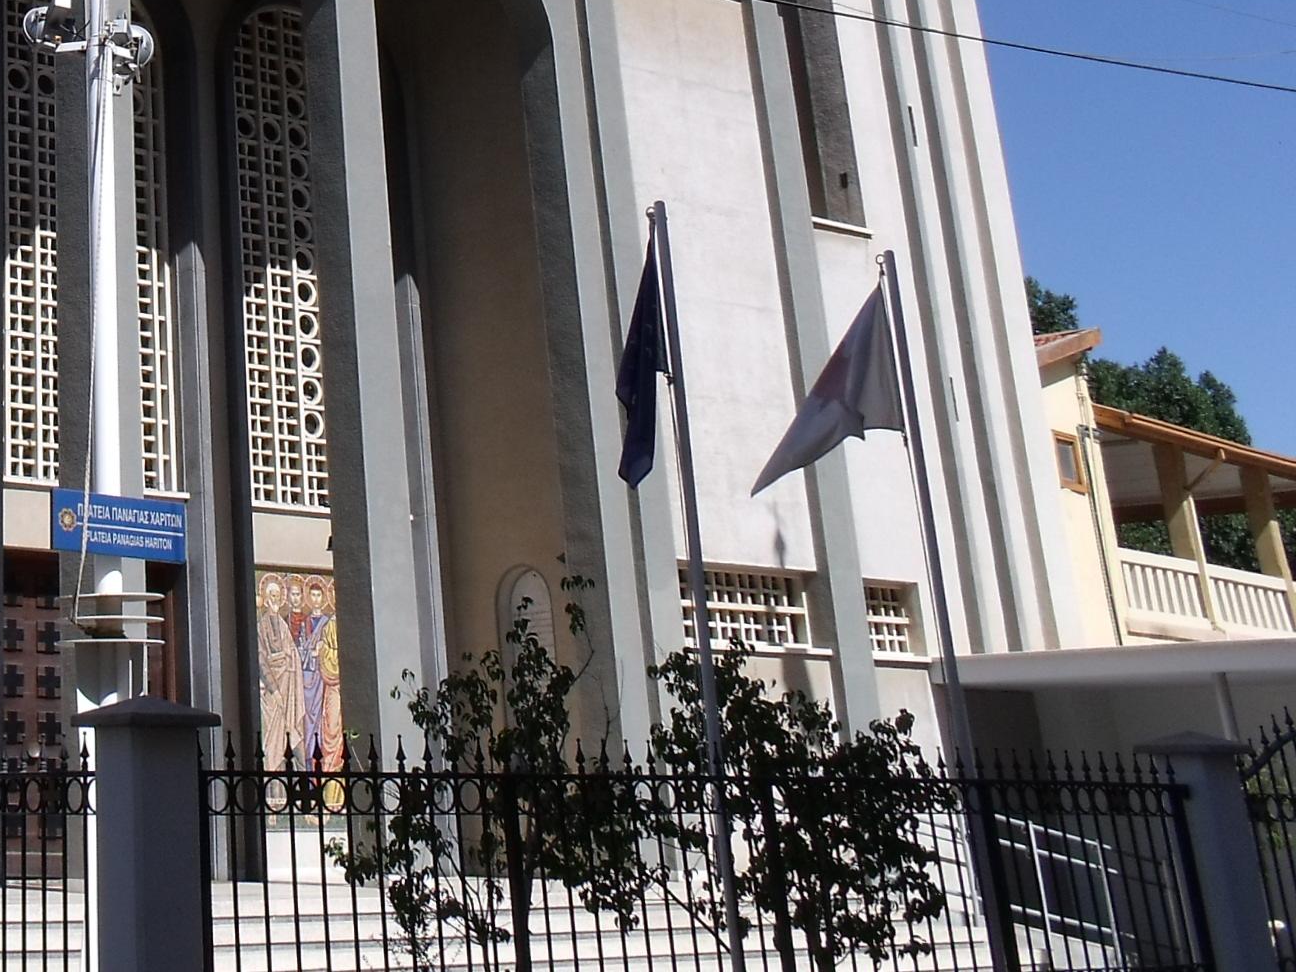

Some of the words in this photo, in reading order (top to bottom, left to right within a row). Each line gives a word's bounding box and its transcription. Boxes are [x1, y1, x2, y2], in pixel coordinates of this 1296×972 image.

[77, 502, 111, 519] ΠΑΤΕΙΑ
[111, 506, 149, 525] ΠΑΝΑΓΙΑΣ
[149, 511, 183, 529] ΧΑΡΙΤΩΝ
[112, 532, 144, 547] PANAGIAS
[144, 536, 172, 550] HARITON
